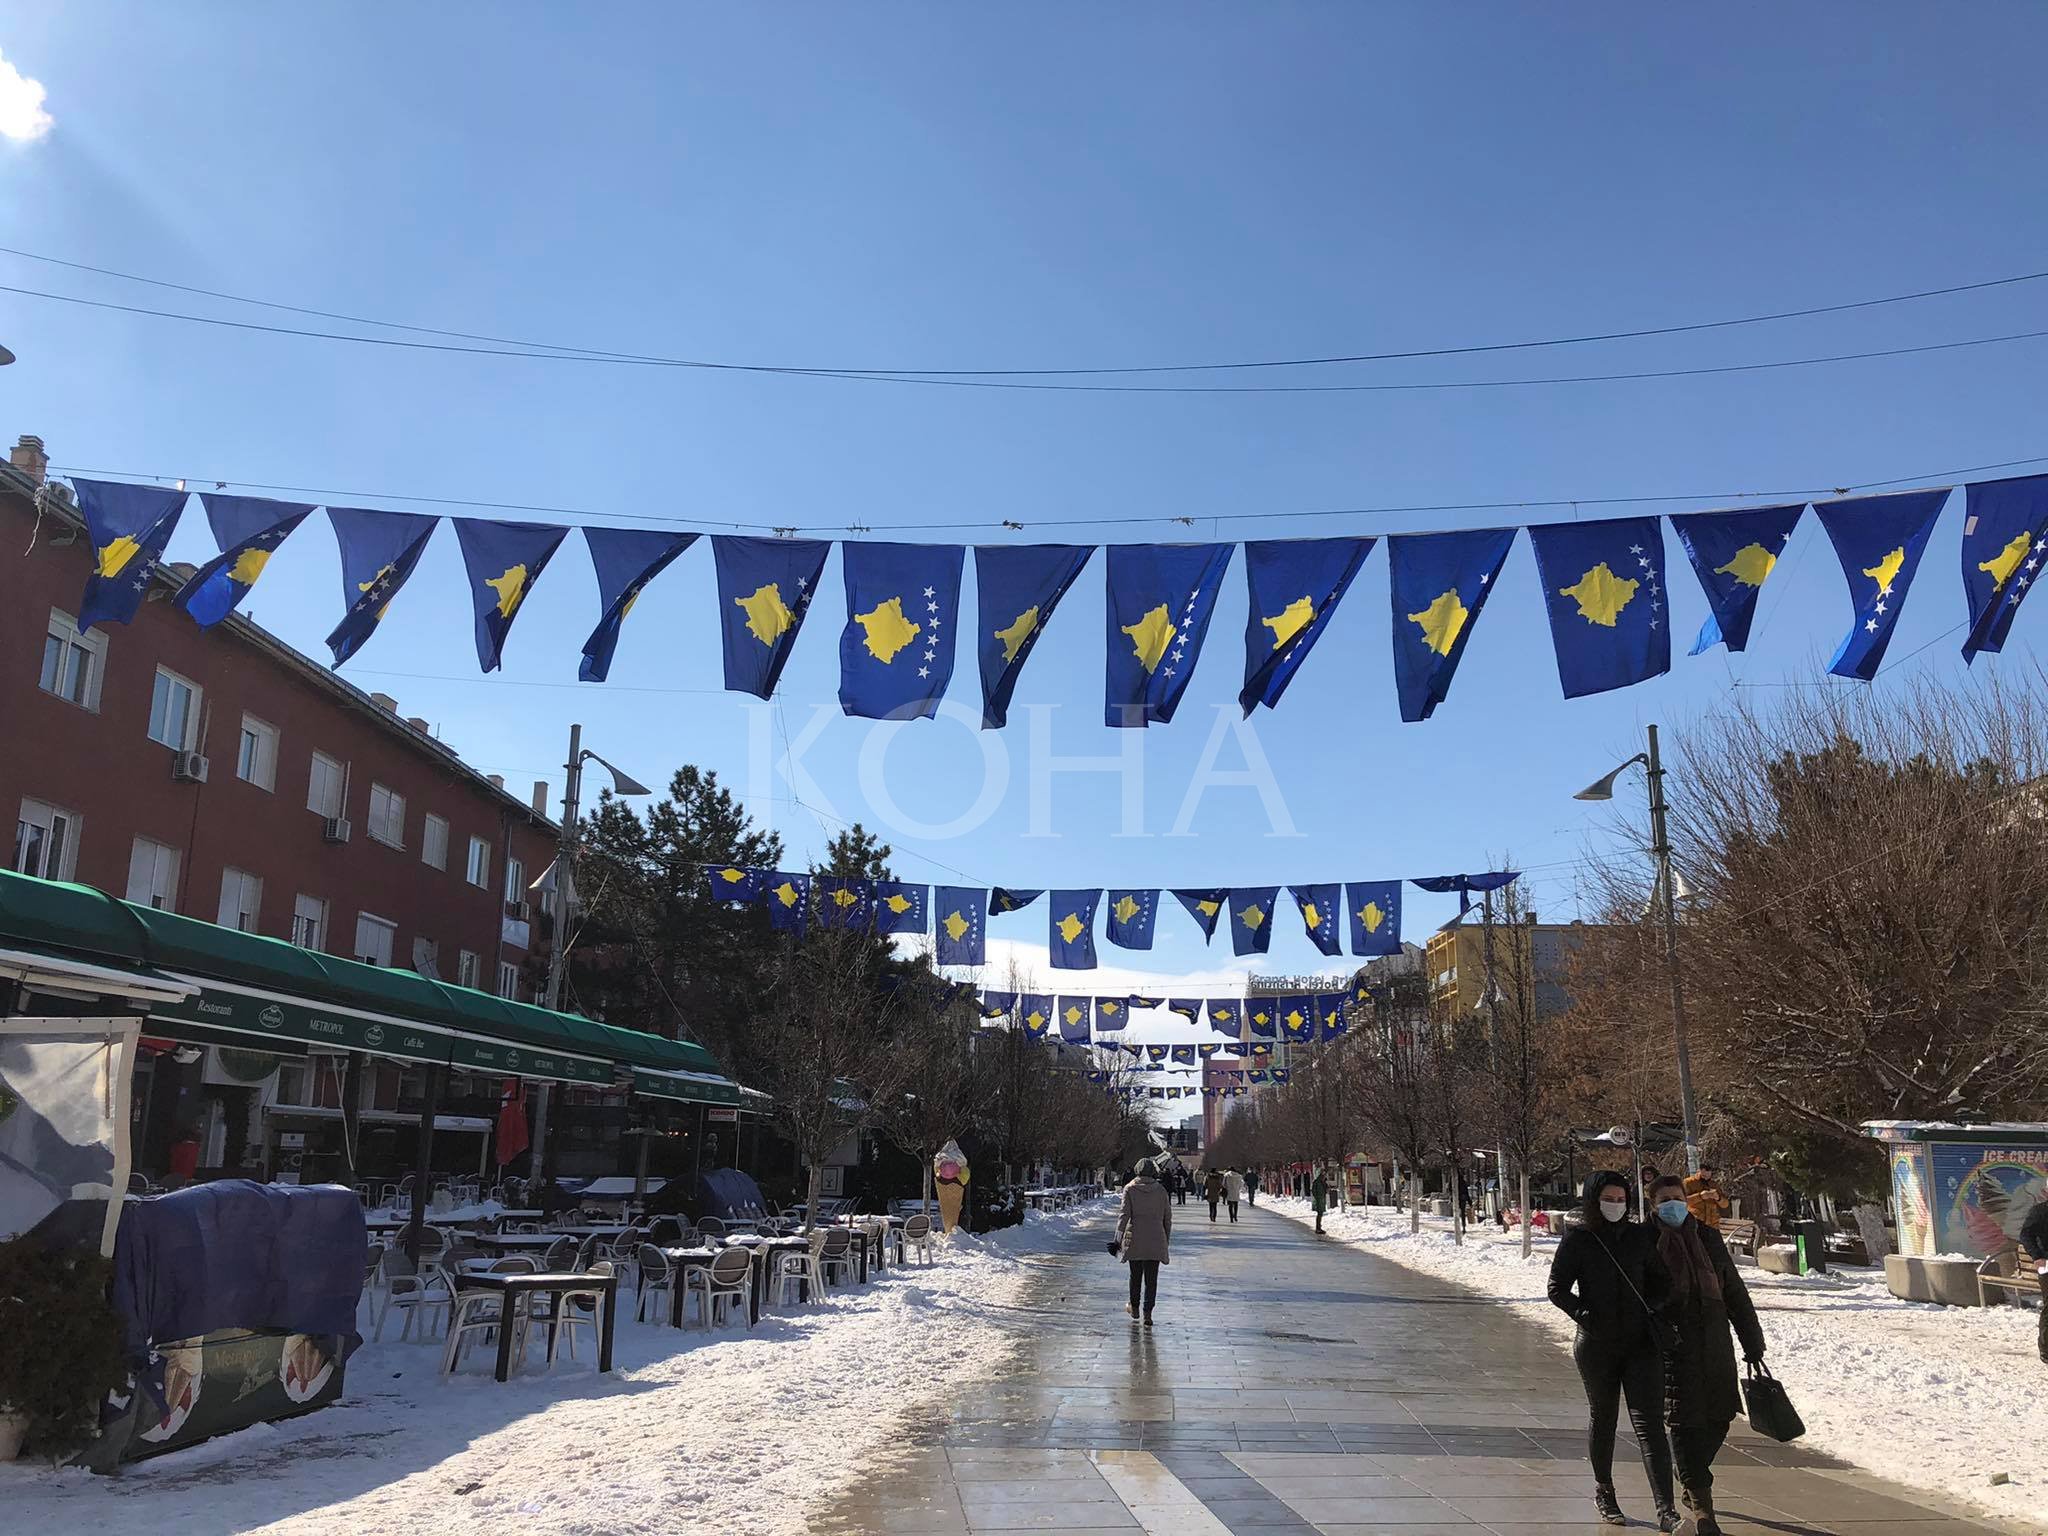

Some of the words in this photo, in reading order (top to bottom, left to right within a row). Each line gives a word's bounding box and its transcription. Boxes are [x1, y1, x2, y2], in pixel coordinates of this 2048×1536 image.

[1252, 974, 1288, 984] Grand
[1293, 974, 1325, 984] Hotel
[309, 1018, 345, 1035] METROPOL
[1984, 1149, 2005, 1163] ICE
